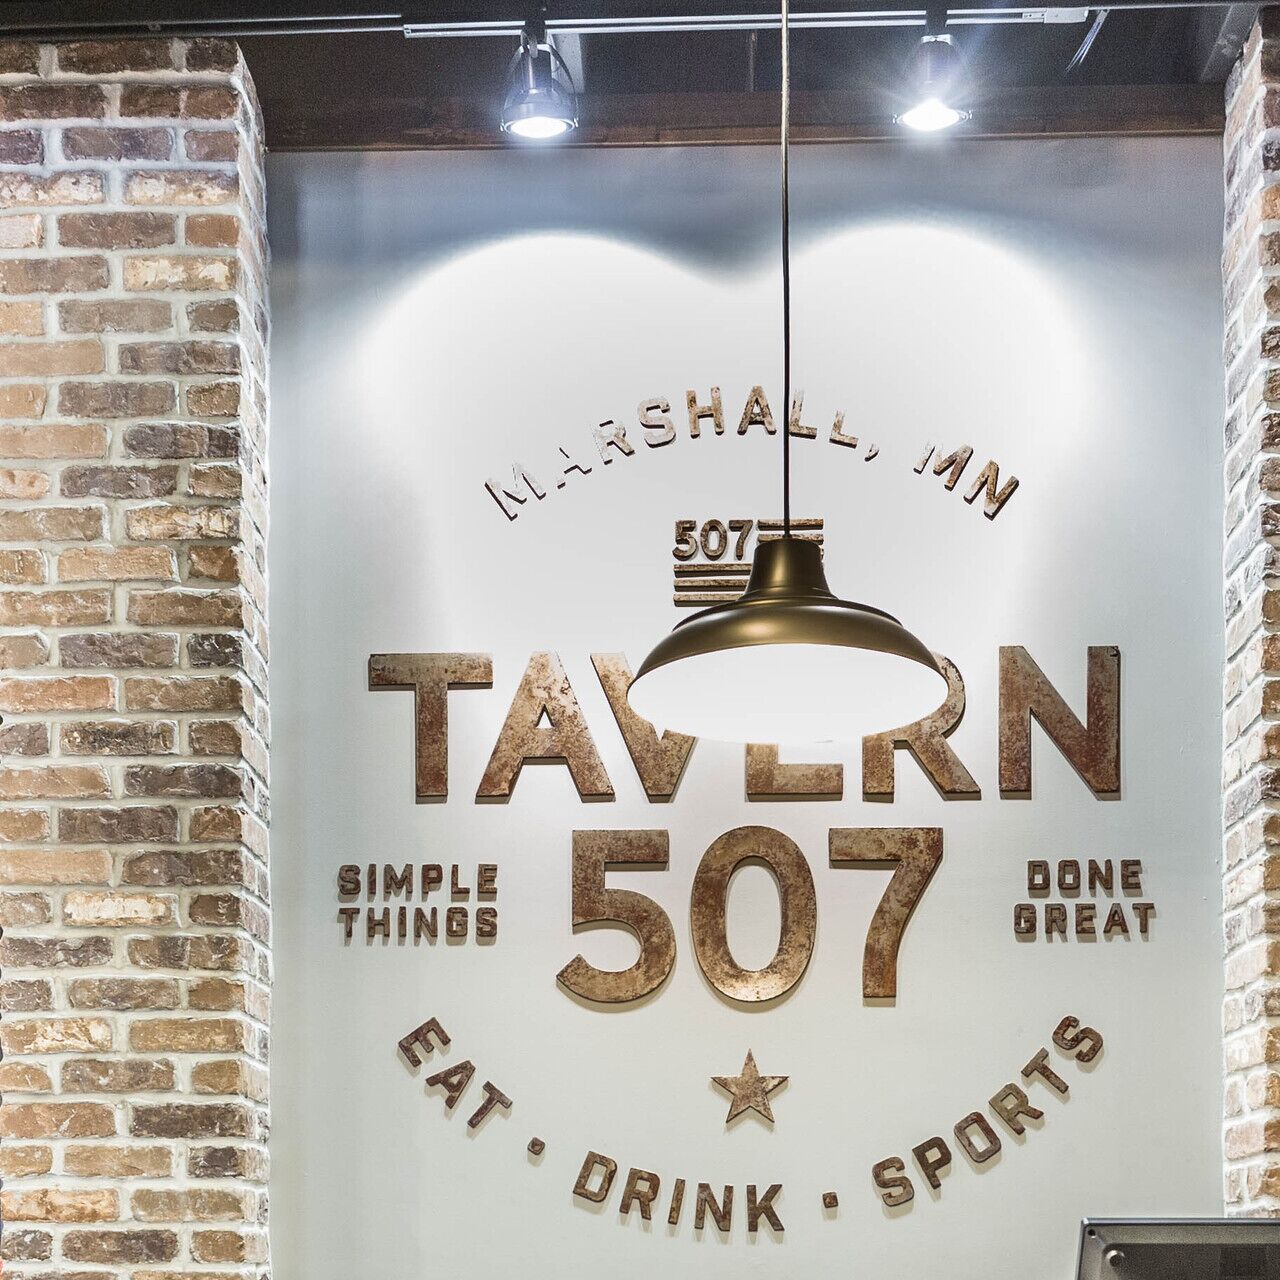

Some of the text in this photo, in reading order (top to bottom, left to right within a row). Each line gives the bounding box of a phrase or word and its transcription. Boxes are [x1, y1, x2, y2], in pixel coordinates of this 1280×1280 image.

[913, 441, 1019, 521] MN
[673, 519, 753, 561] 507
[338, 863, 498, 895] SIMPLE
[1027, 859, 1142, 890] DONE
[338, 906, 498, 938] THINGS
[556, 826, 943, 1003] 507
[1014, 903, 1155, 934] GREAT
[397, 1015, 1103, 1232] EAT DRINK SPORTS
